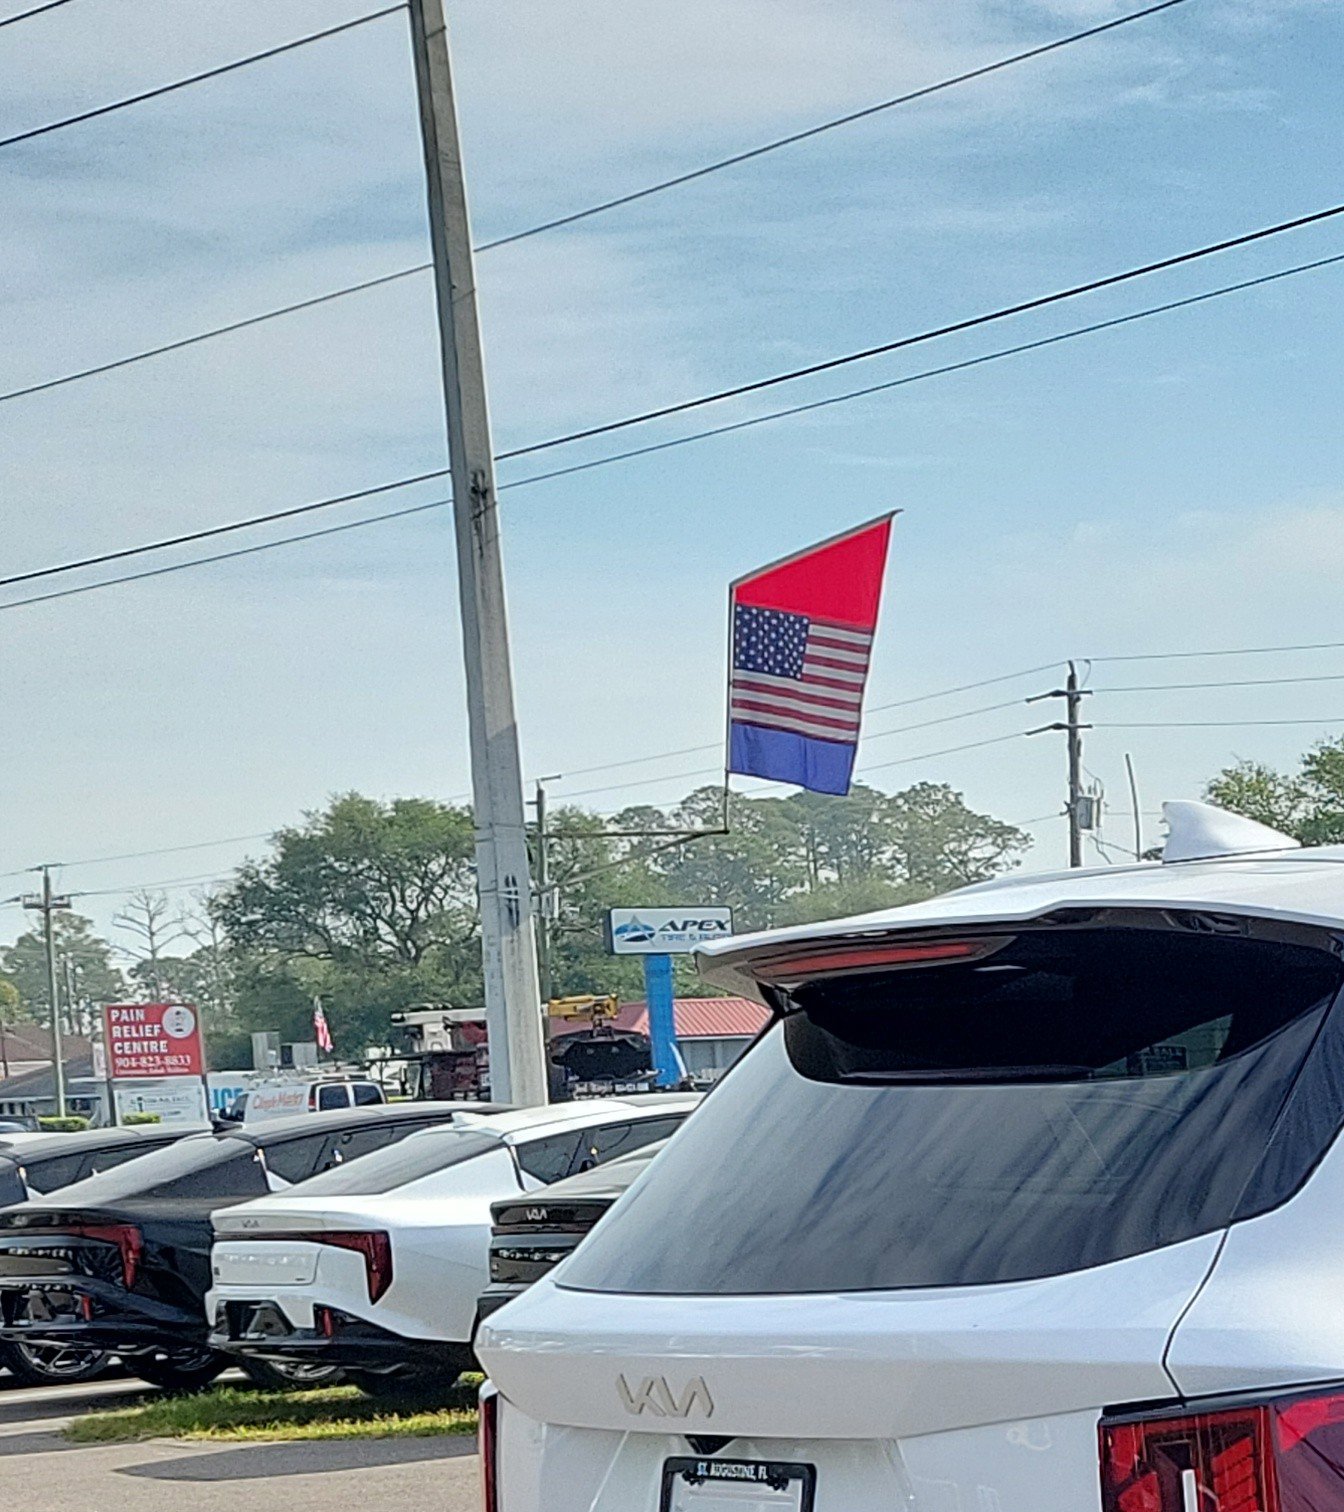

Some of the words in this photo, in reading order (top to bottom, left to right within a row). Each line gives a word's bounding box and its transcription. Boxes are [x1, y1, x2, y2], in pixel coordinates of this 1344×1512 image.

[658, 919, 731, 932] APEX
[110, 1009, 145, 1022] PAIN
[112, 1024, 161, 1039] RELIEF
[114, 1040, 168, 1055] CENTRE
[616, 1373, 714, 1418] KIA
